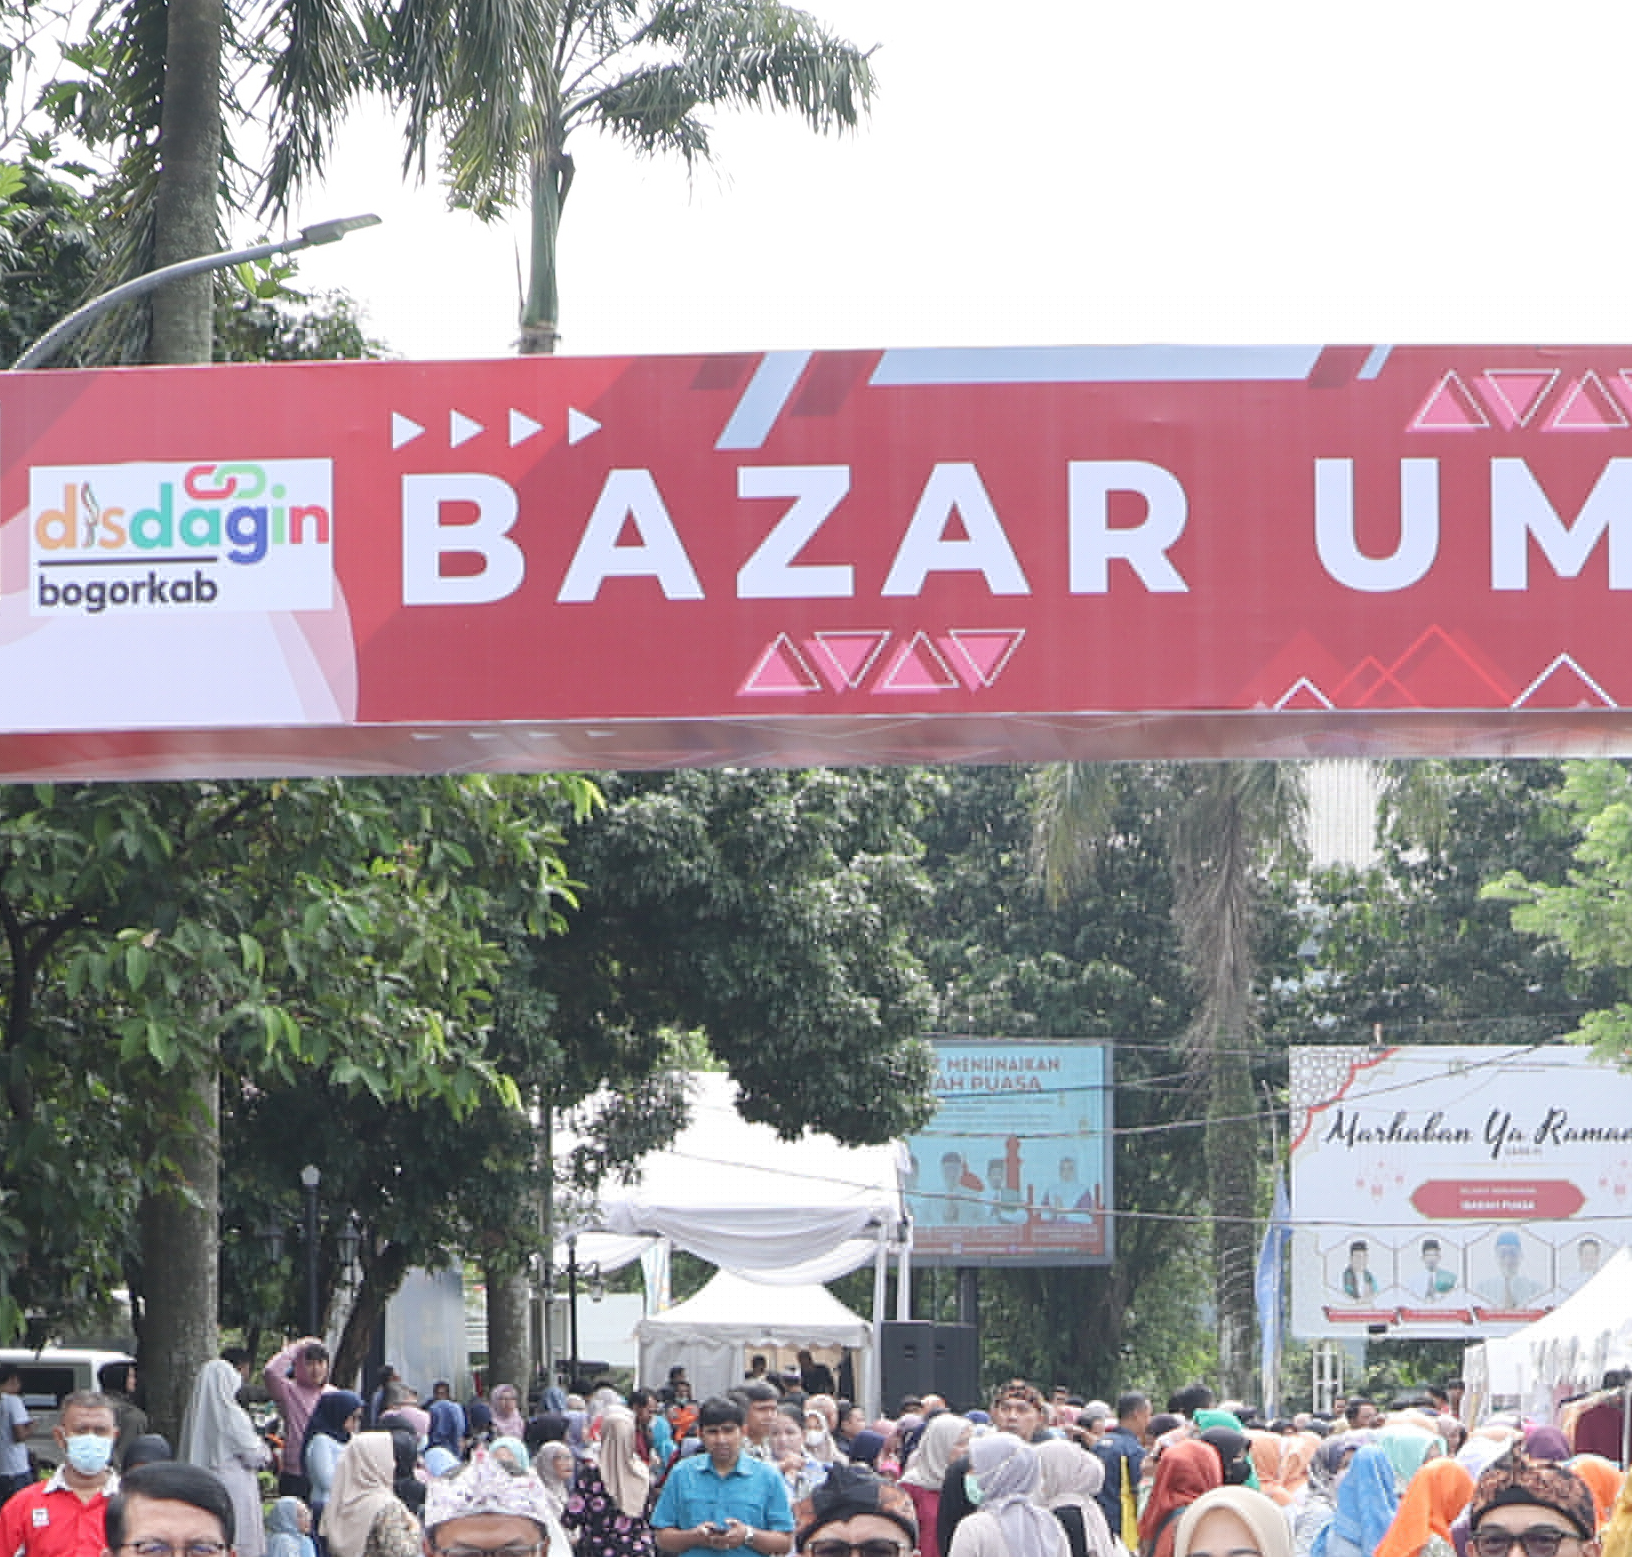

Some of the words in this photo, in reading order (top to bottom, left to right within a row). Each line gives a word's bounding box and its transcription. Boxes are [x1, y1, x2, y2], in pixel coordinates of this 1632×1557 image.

[400, 460, 1189, 605] BAZAR
[38, 570, 218, 613] bogorkab
[971, 1075, 1042, 1093] PUASA
[1323, 1107, 1474, 1152] Marhaban
[1483, 1107, 1527, 1160] Ya
